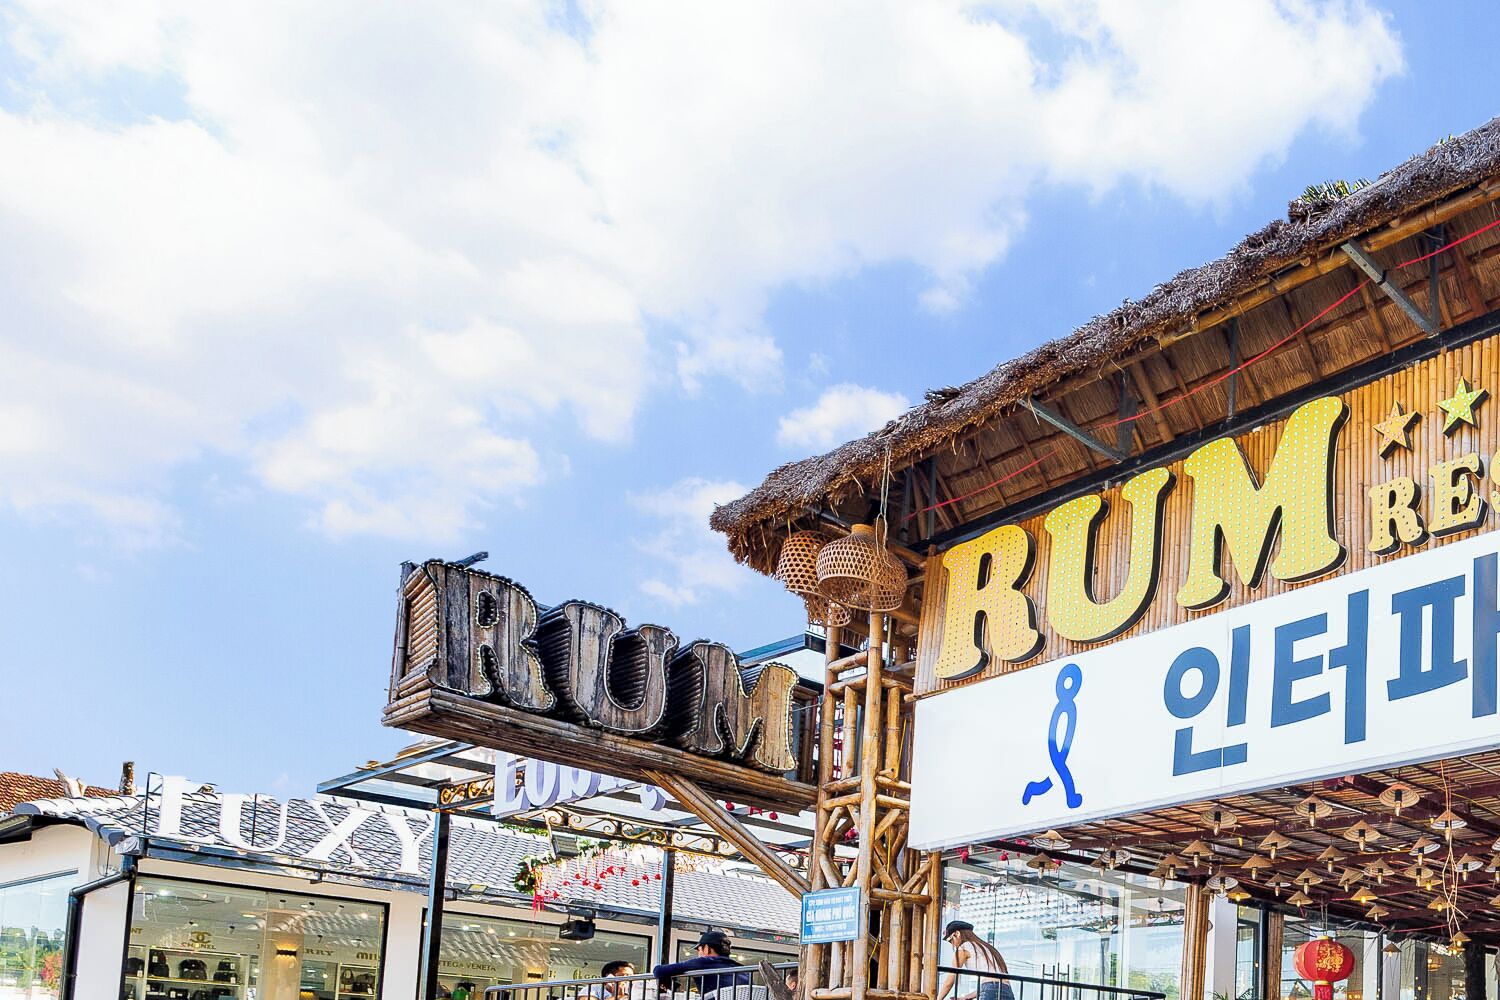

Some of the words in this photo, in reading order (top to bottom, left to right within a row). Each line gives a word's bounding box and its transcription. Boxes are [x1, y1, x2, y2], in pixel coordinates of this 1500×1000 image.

[935, 396, 1350, 680] RUM
[426, 560, 800, 772] RUM
[158, 776, 436, 875] LUXY
